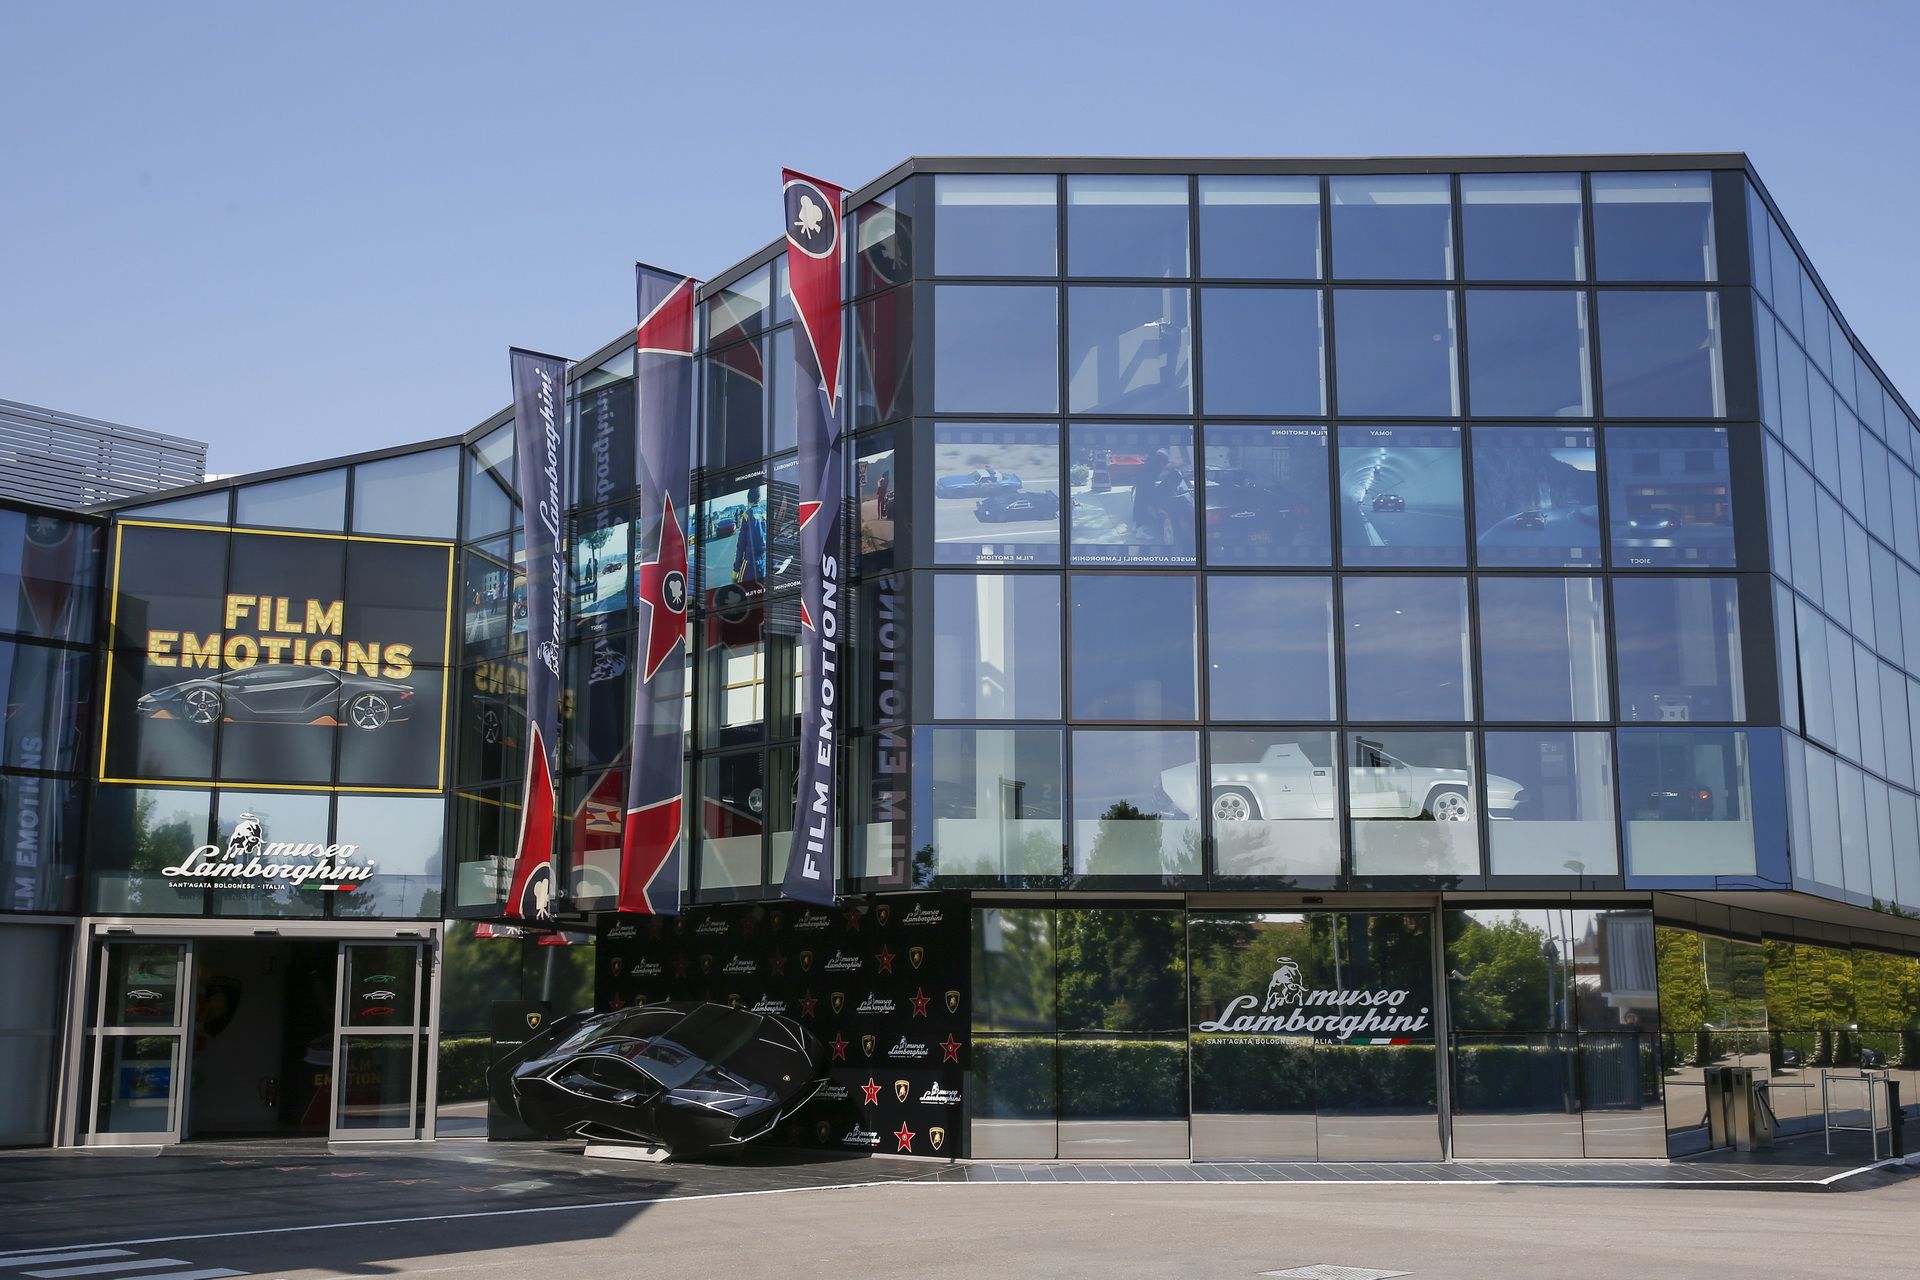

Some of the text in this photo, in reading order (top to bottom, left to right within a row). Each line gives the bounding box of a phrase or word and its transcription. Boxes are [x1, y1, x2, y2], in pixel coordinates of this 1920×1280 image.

[535, 367, 565, 642] museo Lamborghini
[225, 593, 344, 636] FILM
[147, 629, 414, 680] EMOTIONS
[802, 554, 838, 881] FILM EMOTIONS
[263, 842, 359, 858] museo
[161, 844, 375, 886] Lamborghini
[214, 882, 255, 890] BOLOGNESE
[1304, 990, 1410, 1006] museo
[1198, 995, 1429, 1040] Lamborghini
[888, 1045, 929, 1057] Lamborghini
[919, 1090, 962, 1103] Lamborghini
[842, 1134, 881, 1144] Lamborghini
